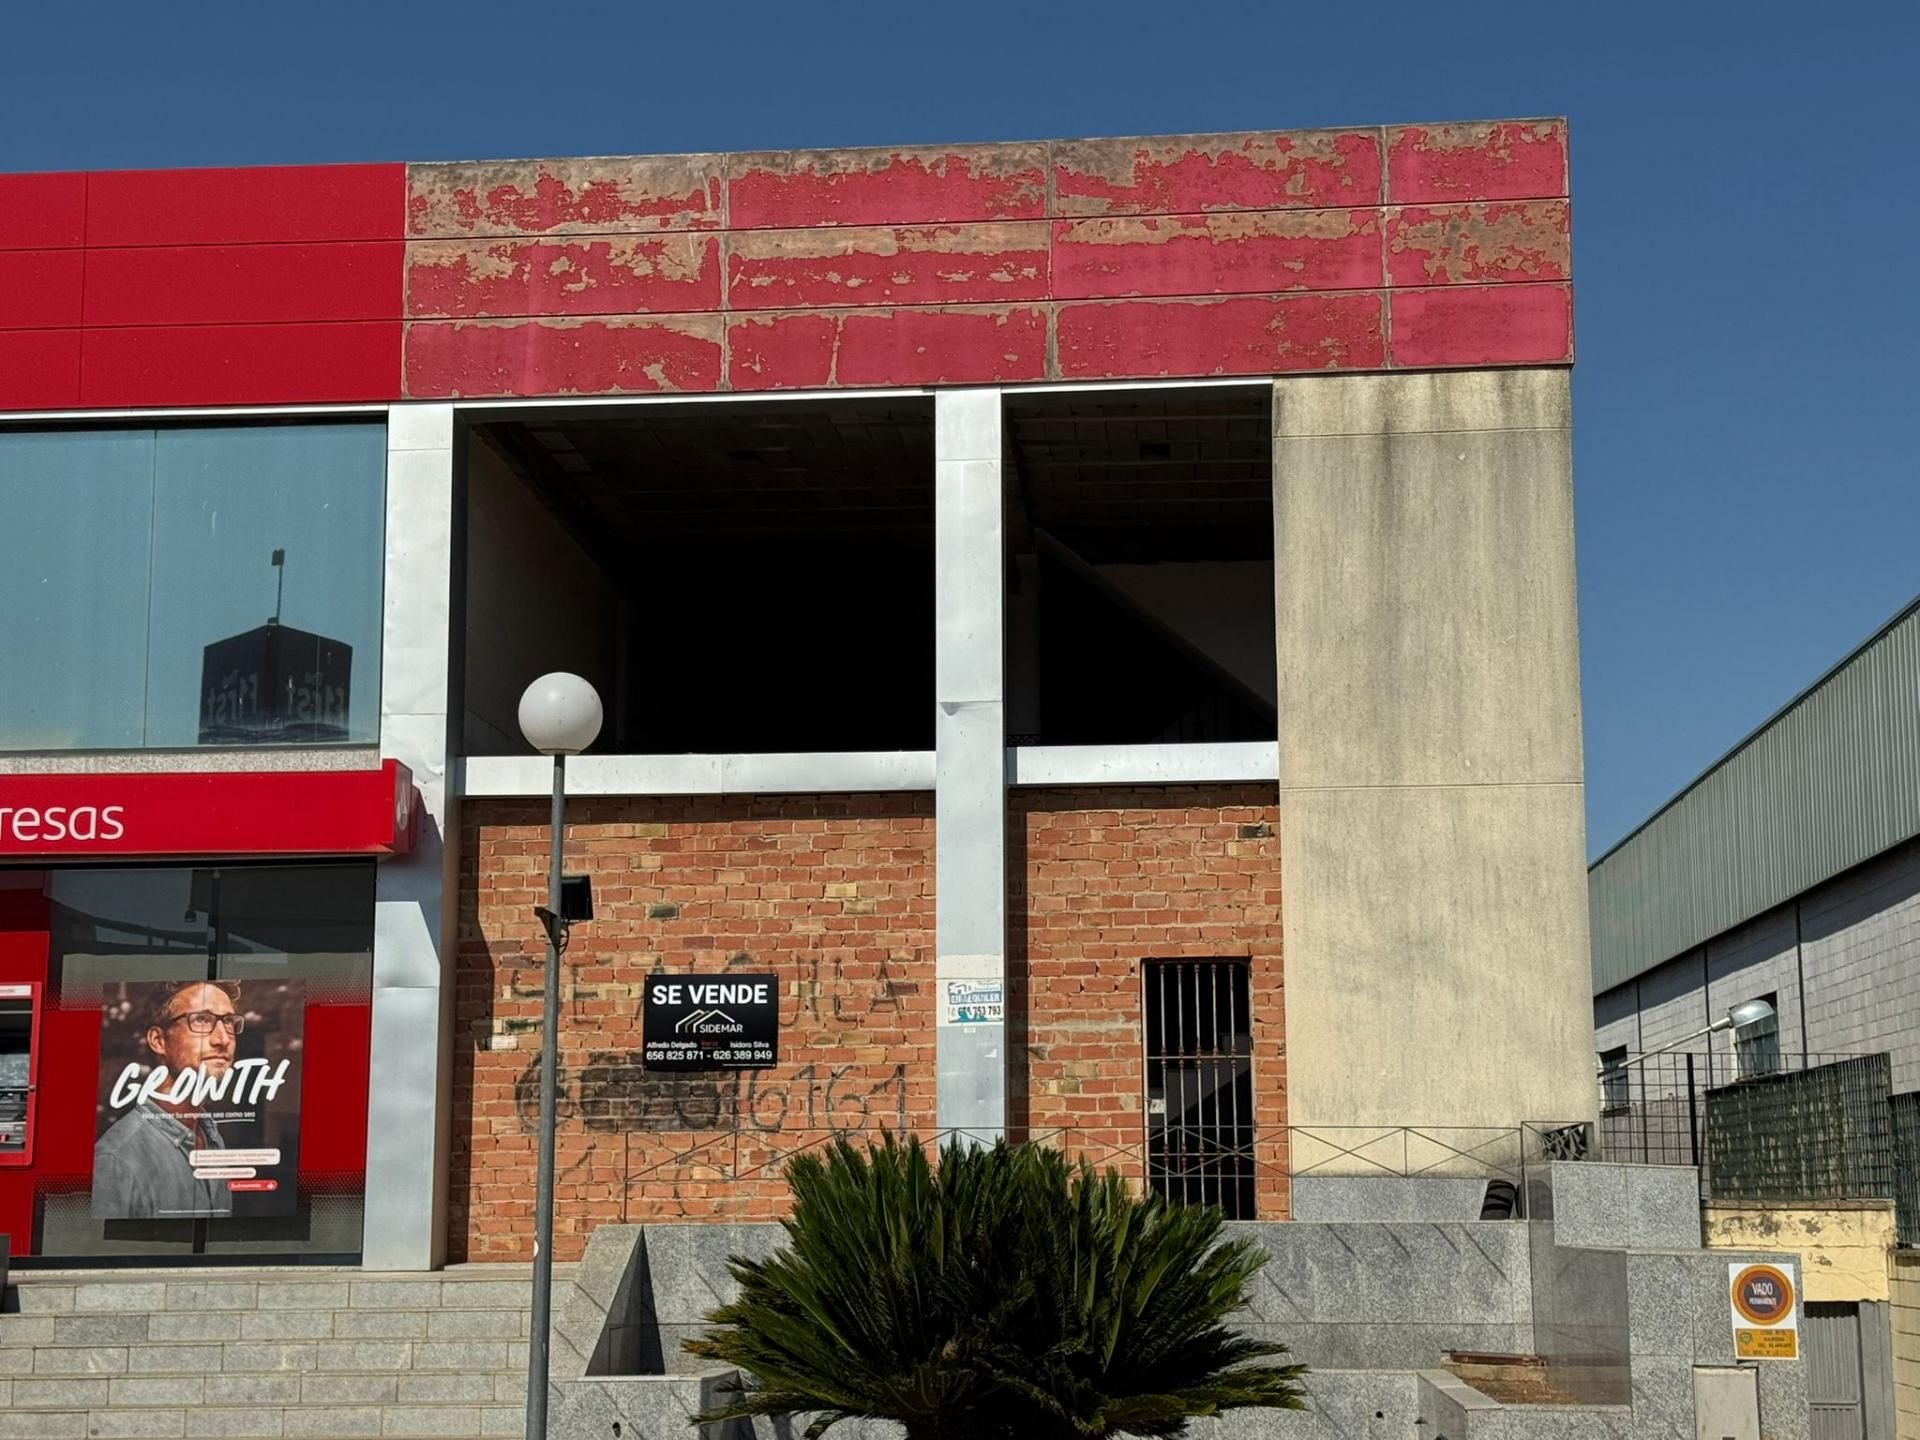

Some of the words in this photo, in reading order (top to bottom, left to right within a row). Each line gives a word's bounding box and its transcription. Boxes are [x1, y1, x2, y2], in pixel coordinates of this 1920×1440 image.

[652, 984, 682, 1005] SE
[688, 984, 769, 1004] VENDE
[988, 1006, 1001, 1015] 793
[699, 1023, 744, 1033] SIDEMAR
[646, 1041, 670, 1049] Alfredo
[671, 1041, 698, 1050] Delgado
[646, 1051, 664, 1060] 656
[666, 1051, 684, 1060] 825
[686, 1050, 704, 1060] 871
[712, 1050, 732, 1060] 626
[733, 1050, 752, 1060] 389
[754, 1050, 772, 1060] 949
[110, 1058, 290, 1109] GROWTH
[1752, 1282, 1773, 1295] VADO
